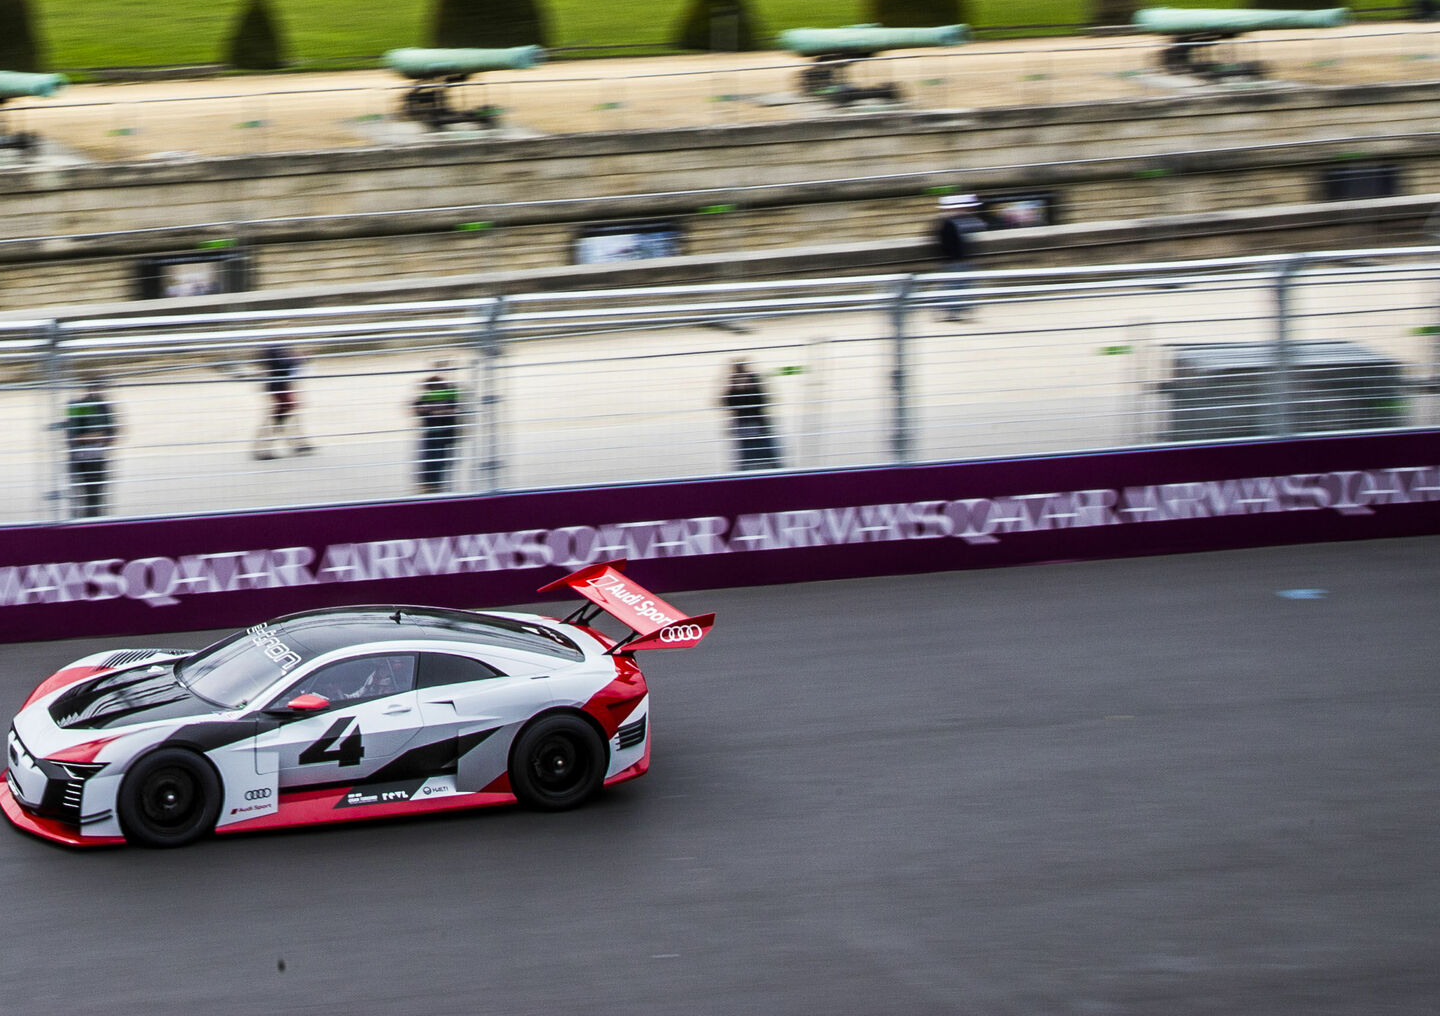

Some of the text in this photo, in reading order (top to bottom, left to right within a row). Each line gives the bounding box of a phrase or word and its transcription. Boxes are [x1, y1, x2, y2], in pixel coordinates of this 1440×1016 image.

[121, 546, 319, 607] QATAR
[317, 529, 552, 584] AIRWAYS
[548, 516, 732, 573] QATAR
[729, 500, 952, 552] AIRWAYS
[950, 489, 1122, 544] QATAR
[605, 583, 678, 627] Audi Sport
[298, 715, 365, 767] 4
